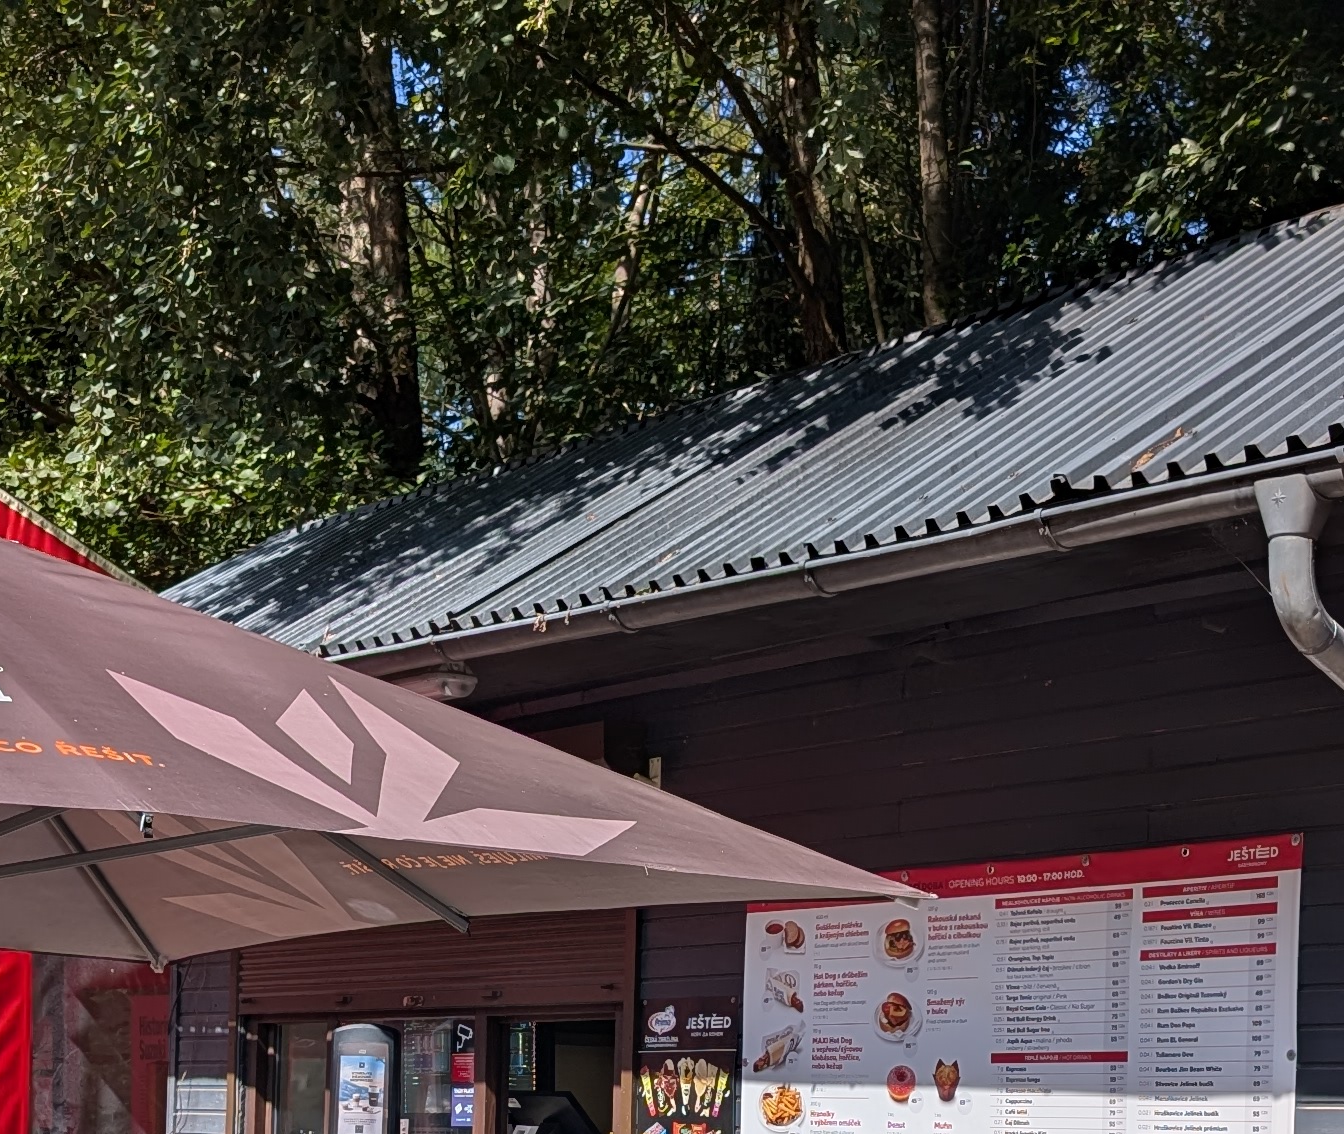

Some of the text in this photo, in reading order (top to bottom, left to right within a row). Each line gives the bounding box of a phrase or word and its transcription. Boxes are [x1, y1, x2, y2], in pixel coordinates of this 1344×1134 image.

[55, 740, 166, 768] ŘEŠIT.
[1227, 845, 1279, 862] JEŠTĚD
[948, 877, 985, 889] OPENING
[986, 875, 1015, 887] HOURS
[1064, 869, 1085, 879] HOD.
[825, 972, 837, 981] Dog
[931, 1007, 948, 1015] bulce
[686, 1013, 732, 1030] JEŠTĚD
[840, 1036, 853, 1045] Dog
